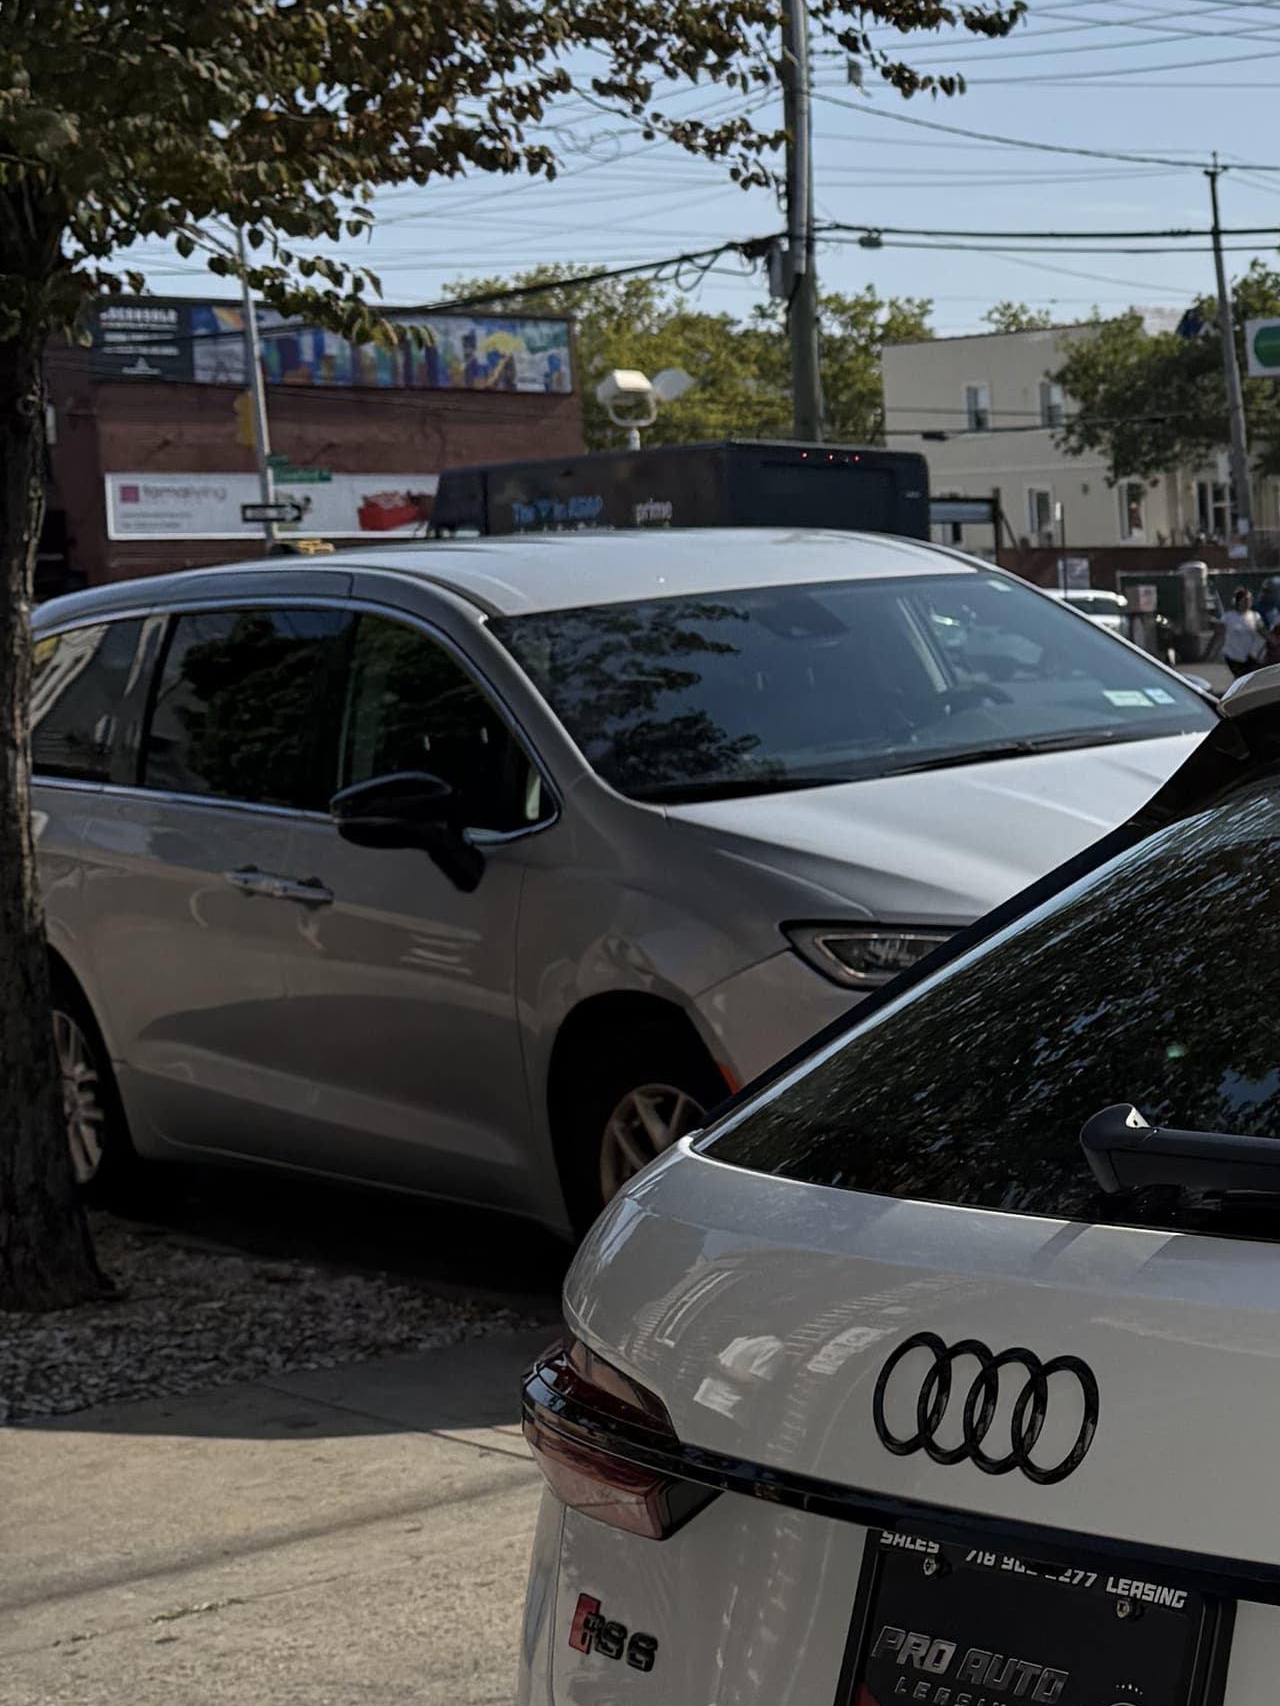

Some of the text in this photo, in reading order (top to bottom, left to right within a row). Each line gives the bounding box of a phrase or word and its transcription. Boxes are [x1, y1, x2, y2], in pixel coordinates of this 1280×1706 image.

[635, 496, 673, 526] prime
[1105, 1576, 1188, 1609] LEASING
[871, 1625, 1070, 1705] PRO AUTO
